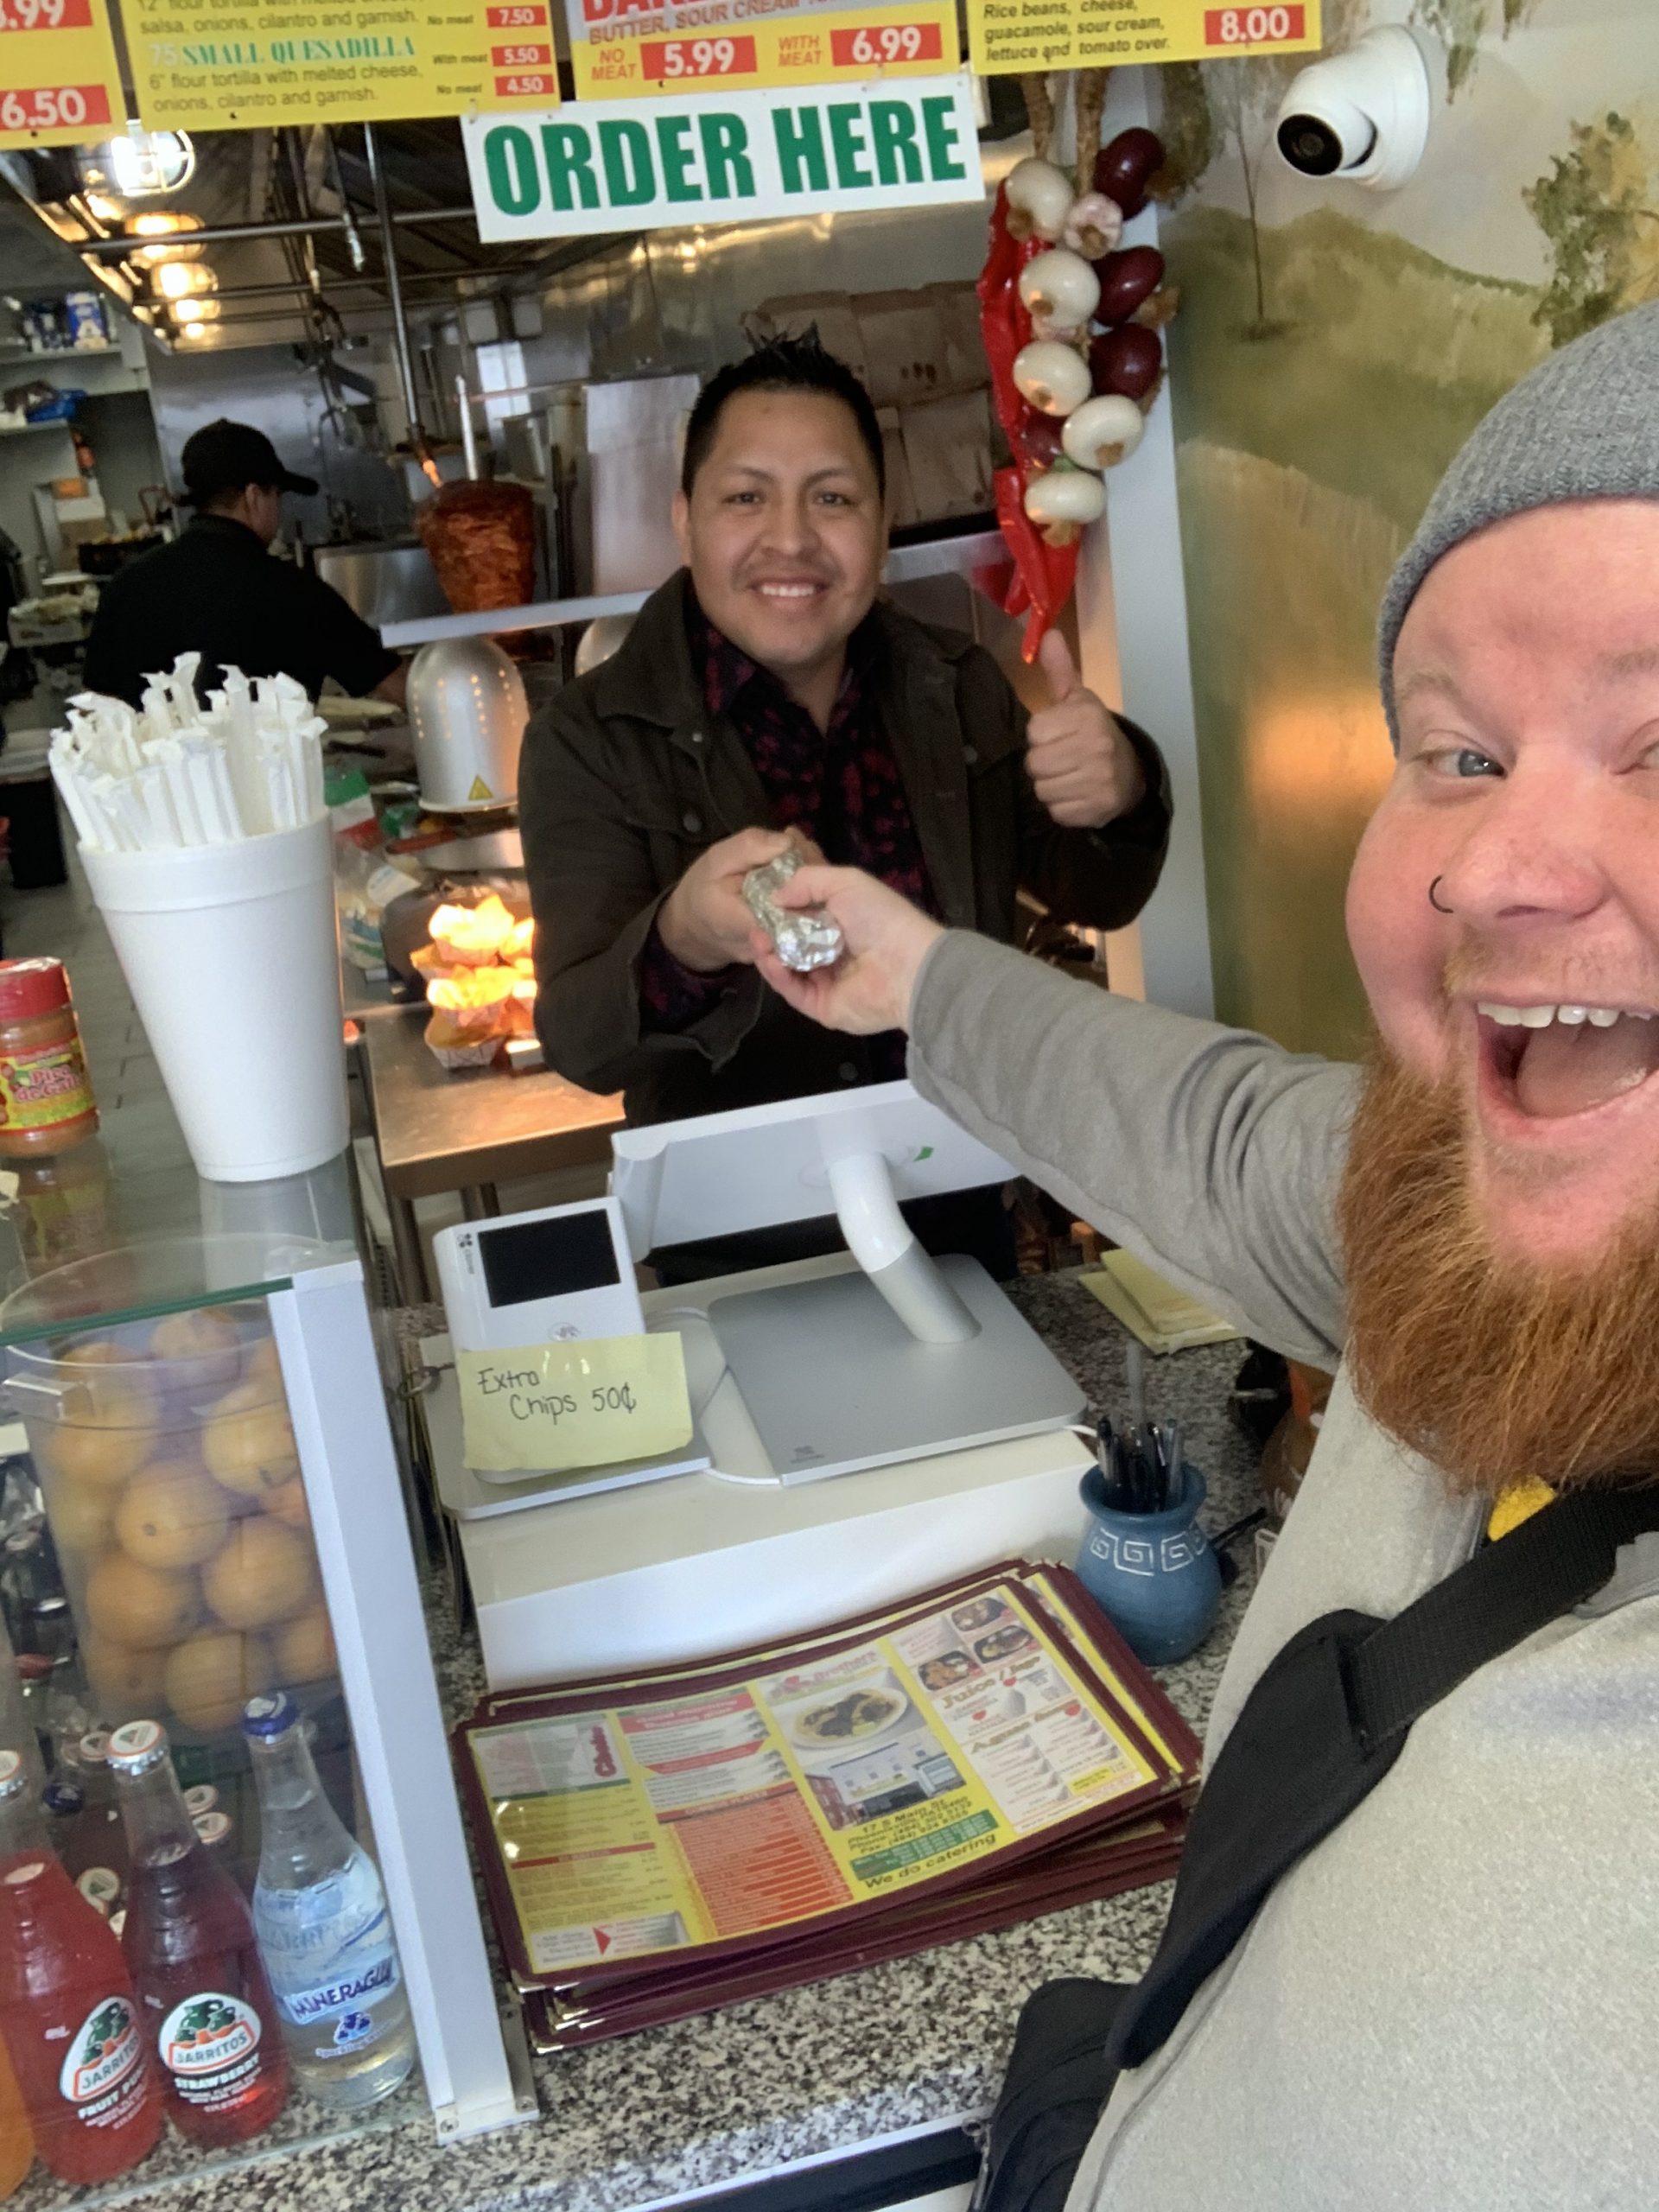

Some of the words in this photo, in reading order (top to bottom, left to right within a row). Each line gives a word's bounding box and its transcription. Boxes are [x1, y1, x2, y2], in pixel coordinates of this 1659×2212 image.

[0, 0, 65, 28] .99
[427, 16, 442, 24] No
[446, 15, 474, 24] meat
[499, 8, 534, 25] 7.50
[984, 4, 1017, 18] Rice
[1022, 3, 1071, 16] beans,
[1081, 0, 1137, 12] cheese,
[194, 17, 254, 32] onions,
[258, 13, 317, 29] cilantro
[322, 11, 352, 26] and
[589, 16, 670, 44] BUTTER,
[676, 4, 728, 29] SOUR
[985, 22, 1071, 43] guacamole,
[1077, 22, 1110, 33] sour
[1115, 17, 1165, 33] cream,
[1221, 8, 1290, 41] 8.00
[149, 44, 178, 66] 75
[182, 41, 265, 65] SMALL
[270, 36, 415, 63] QUESADILLA
[779, 35, 819, 50] WITH
[852, 27, 921, 62] 6.99
[987, 47, 1038, 60] lettuce
[1042, 42, 1071, 57] and
[1079, 40, 1130, 54] tomato
[1135, 38, 1170, 50] over.
[434, 54, 457, 64] With
[461, 54, 487, 63] meat
[504, 48, 538, 63] 5.50
[600, 49, 624, 63] NO
[664, 39, 734, 76] 5.99
[779, 51, 823, 67] MEAT
[171, 73, 206, 87] flour
[212, 70, 260, 86] tortilla
[266, 69, 297, 83] with
[303, 66, 355, 81] melted
[592, 64, 636, 79] MEAT
[436, 85, 451, 94] No
[455, 85, 482, 93] meat
[507, 78, 543, 92] 4.50
[1, 88, 86, 129] 6.50
[154, 97, 213, 111] onions,
[218, 93, 276, 107] cilantro
[282, 89, 310, 104] and
[484, 112, 756, 216] ORDER
[772, 96, 967, 194] HERE
[510, 1395, 577, 1425] Chips
[592, 1382, 637, 1413] 50¢
[865, 1875, 893, 1888] We
[899, 1864, 920, 1878] do
[926, 1834, 996, 1867] catering
[175, 2031, 248, 2063] JARRITOS
